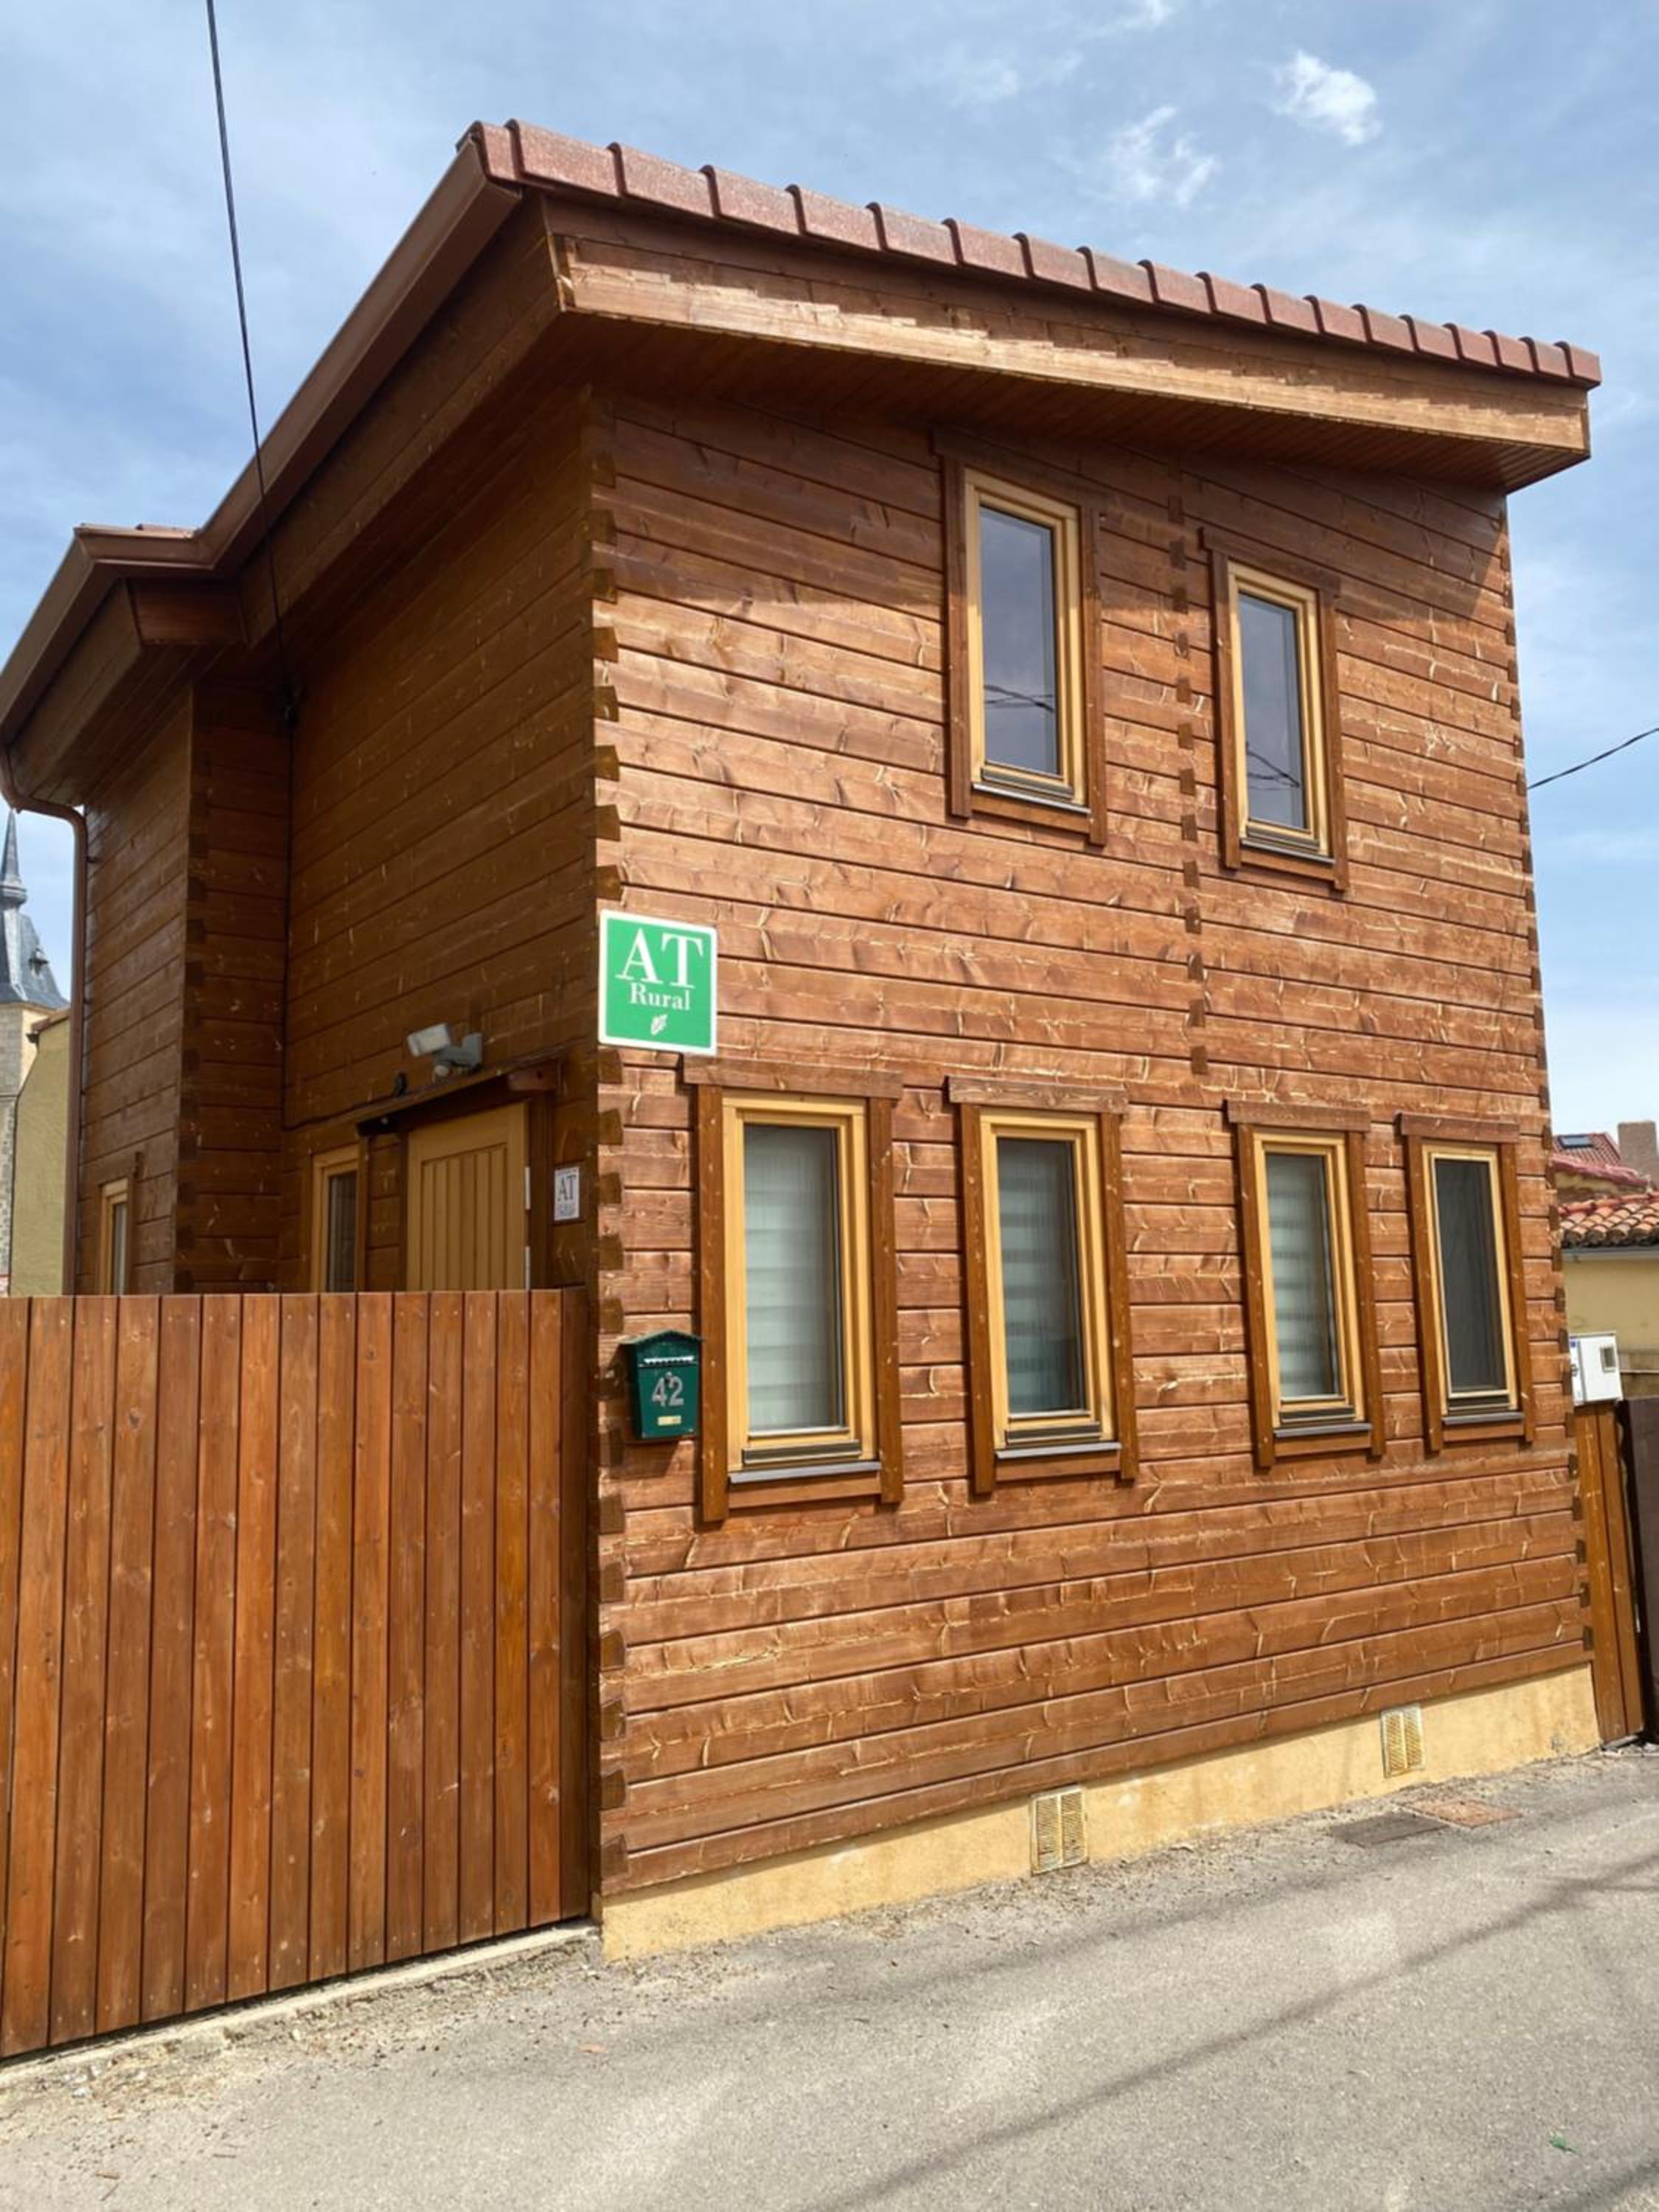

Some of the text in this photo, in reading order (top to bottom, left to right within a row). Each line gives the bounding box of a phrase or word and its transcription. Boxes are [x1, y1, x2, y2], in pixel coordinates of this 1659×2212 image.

[615, 927, 703, 989] AT
[630, 982, 691, 1011] Rural
[557, 1174, 577, 1201] AT
[652, 1376, 684, 1407] 42
